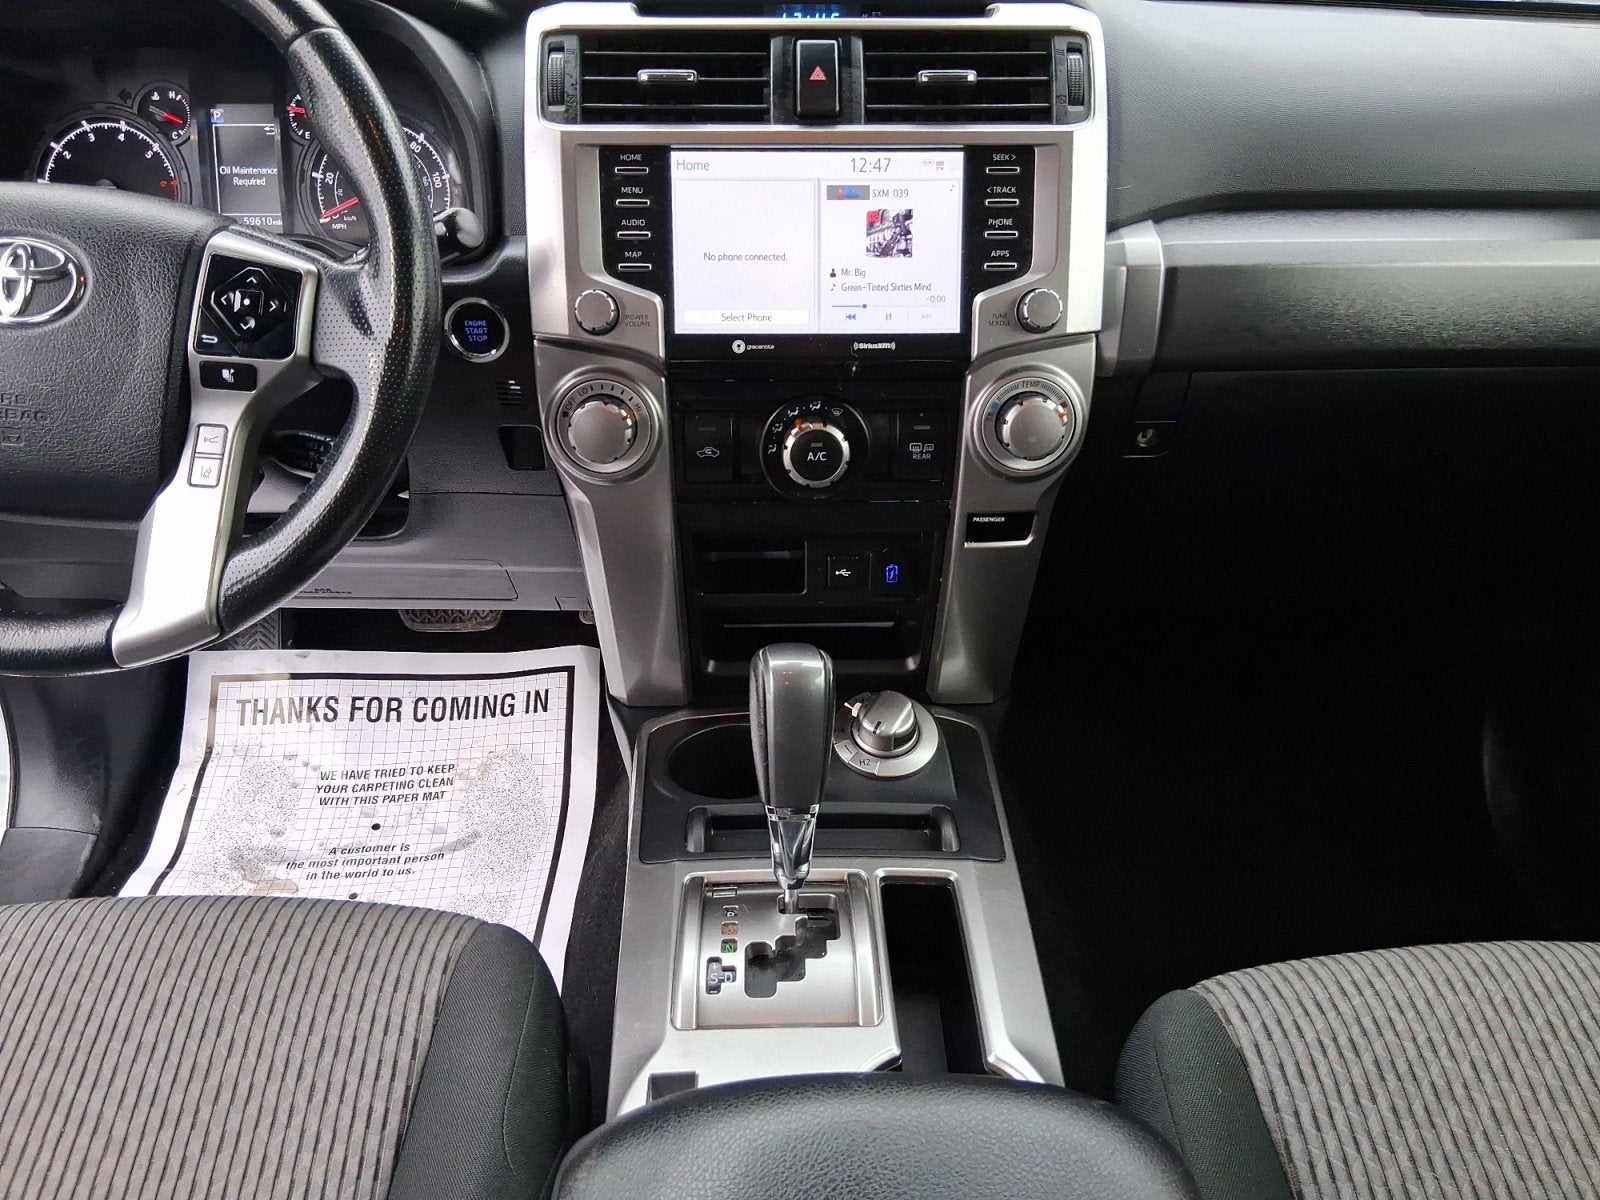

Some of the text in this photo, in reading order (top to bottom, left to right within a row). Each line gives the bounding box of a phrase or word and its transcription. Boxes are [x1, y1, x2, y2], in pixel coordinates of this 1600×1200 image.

[213, 111, 221, 120] P
[88, 133, 95, 142] 3
[118, 133, 125, 142] 4
[410, 141, 422, 154] 80
[62, 151, 72, 160] 2
[145, 151, 154, 159] 5
[676, 159, 710, 170] Home
[850, 158, 892, 173] 12:47
[220, 166, 278, 175] Oil Maintenance
[233, 177, 266, 187] Required
[326, 172, 334, 185] 20
[432, 172, 443, 188] 100
[872, 189, 909, 198] SXM 039
[244, 217, 272, 226] 59610
[988, 218, 1013, 226] PHONE
[704, 252, 788, 262] No phone connected.
[854, 269, 866, 278] Big
[890, 283, 912, 292] Sixties
[914, 283, 932, 292] Mind
[721, 313, 772, 322] Select Phone
[1021, 380, 1040, 388] TEMP
[807, 452, 828, 462] A/C
[236, 688, 550, 726] THANKS FOR COMING IN
[859, 758, 871, 766] H2
[320, 764, 455, 781] WE HAVE TRIED TO KEEP
[317, 777, 454, 794] YOUR CARPETING CLEAN
[319, 790, 446, 806] WITH THIS PAPER MAT
[328, 842, 410, 856] A customer is
[286, 852, 444, 870] the most important person
[306, 867, 416, 880] in the world to us.
[726, 944, 734, 952] N
